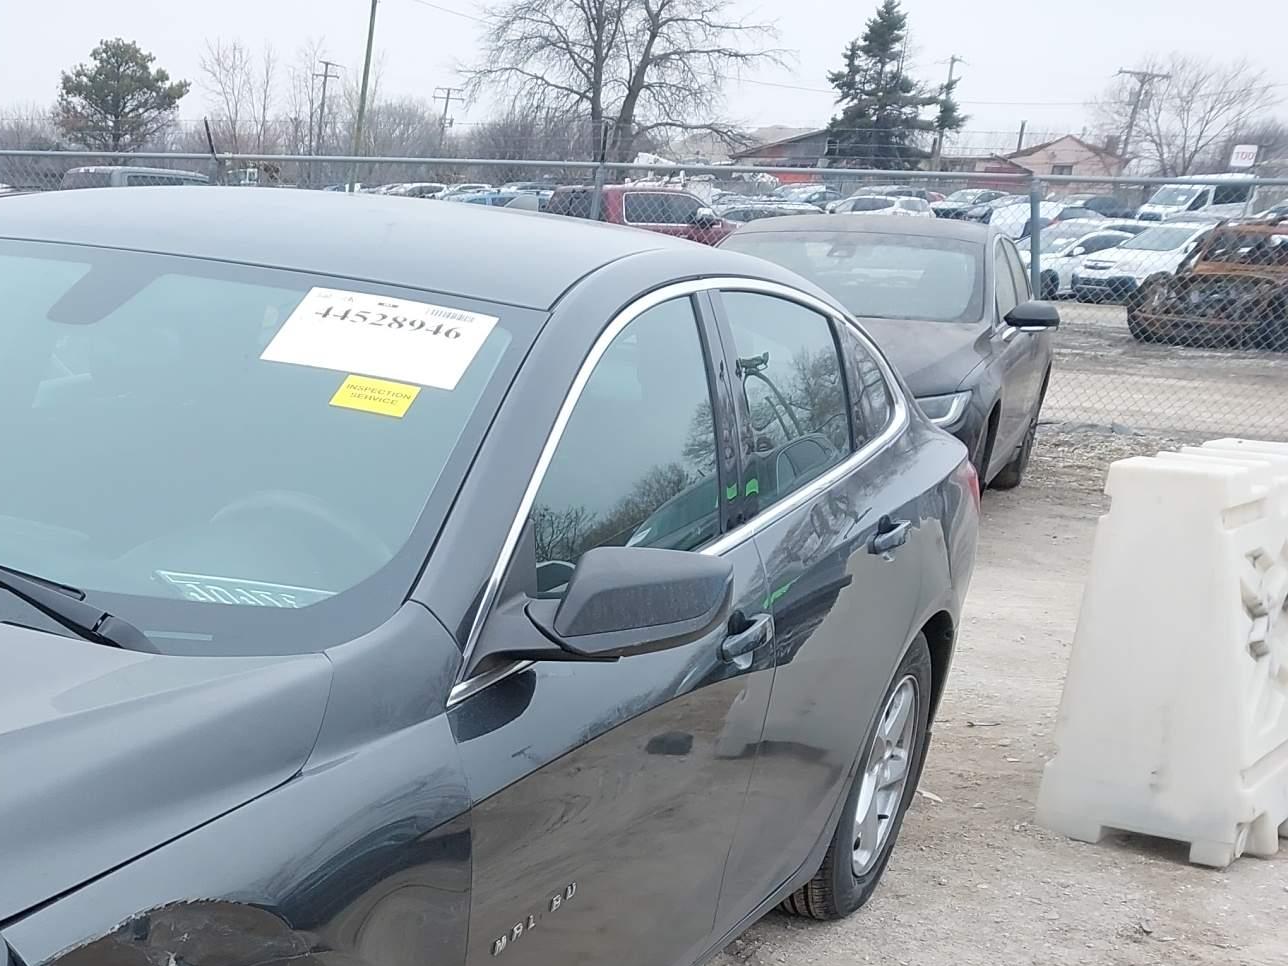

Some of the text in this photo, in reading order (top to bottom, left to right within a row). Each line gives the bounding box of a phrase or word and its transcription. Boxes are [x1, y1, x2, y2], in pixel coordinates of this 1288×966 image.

[314, 305, 462, 340] 44528946
[346, 383, 412, 400] INSPECTION
[350, 391, 399, 406] SERVICE
